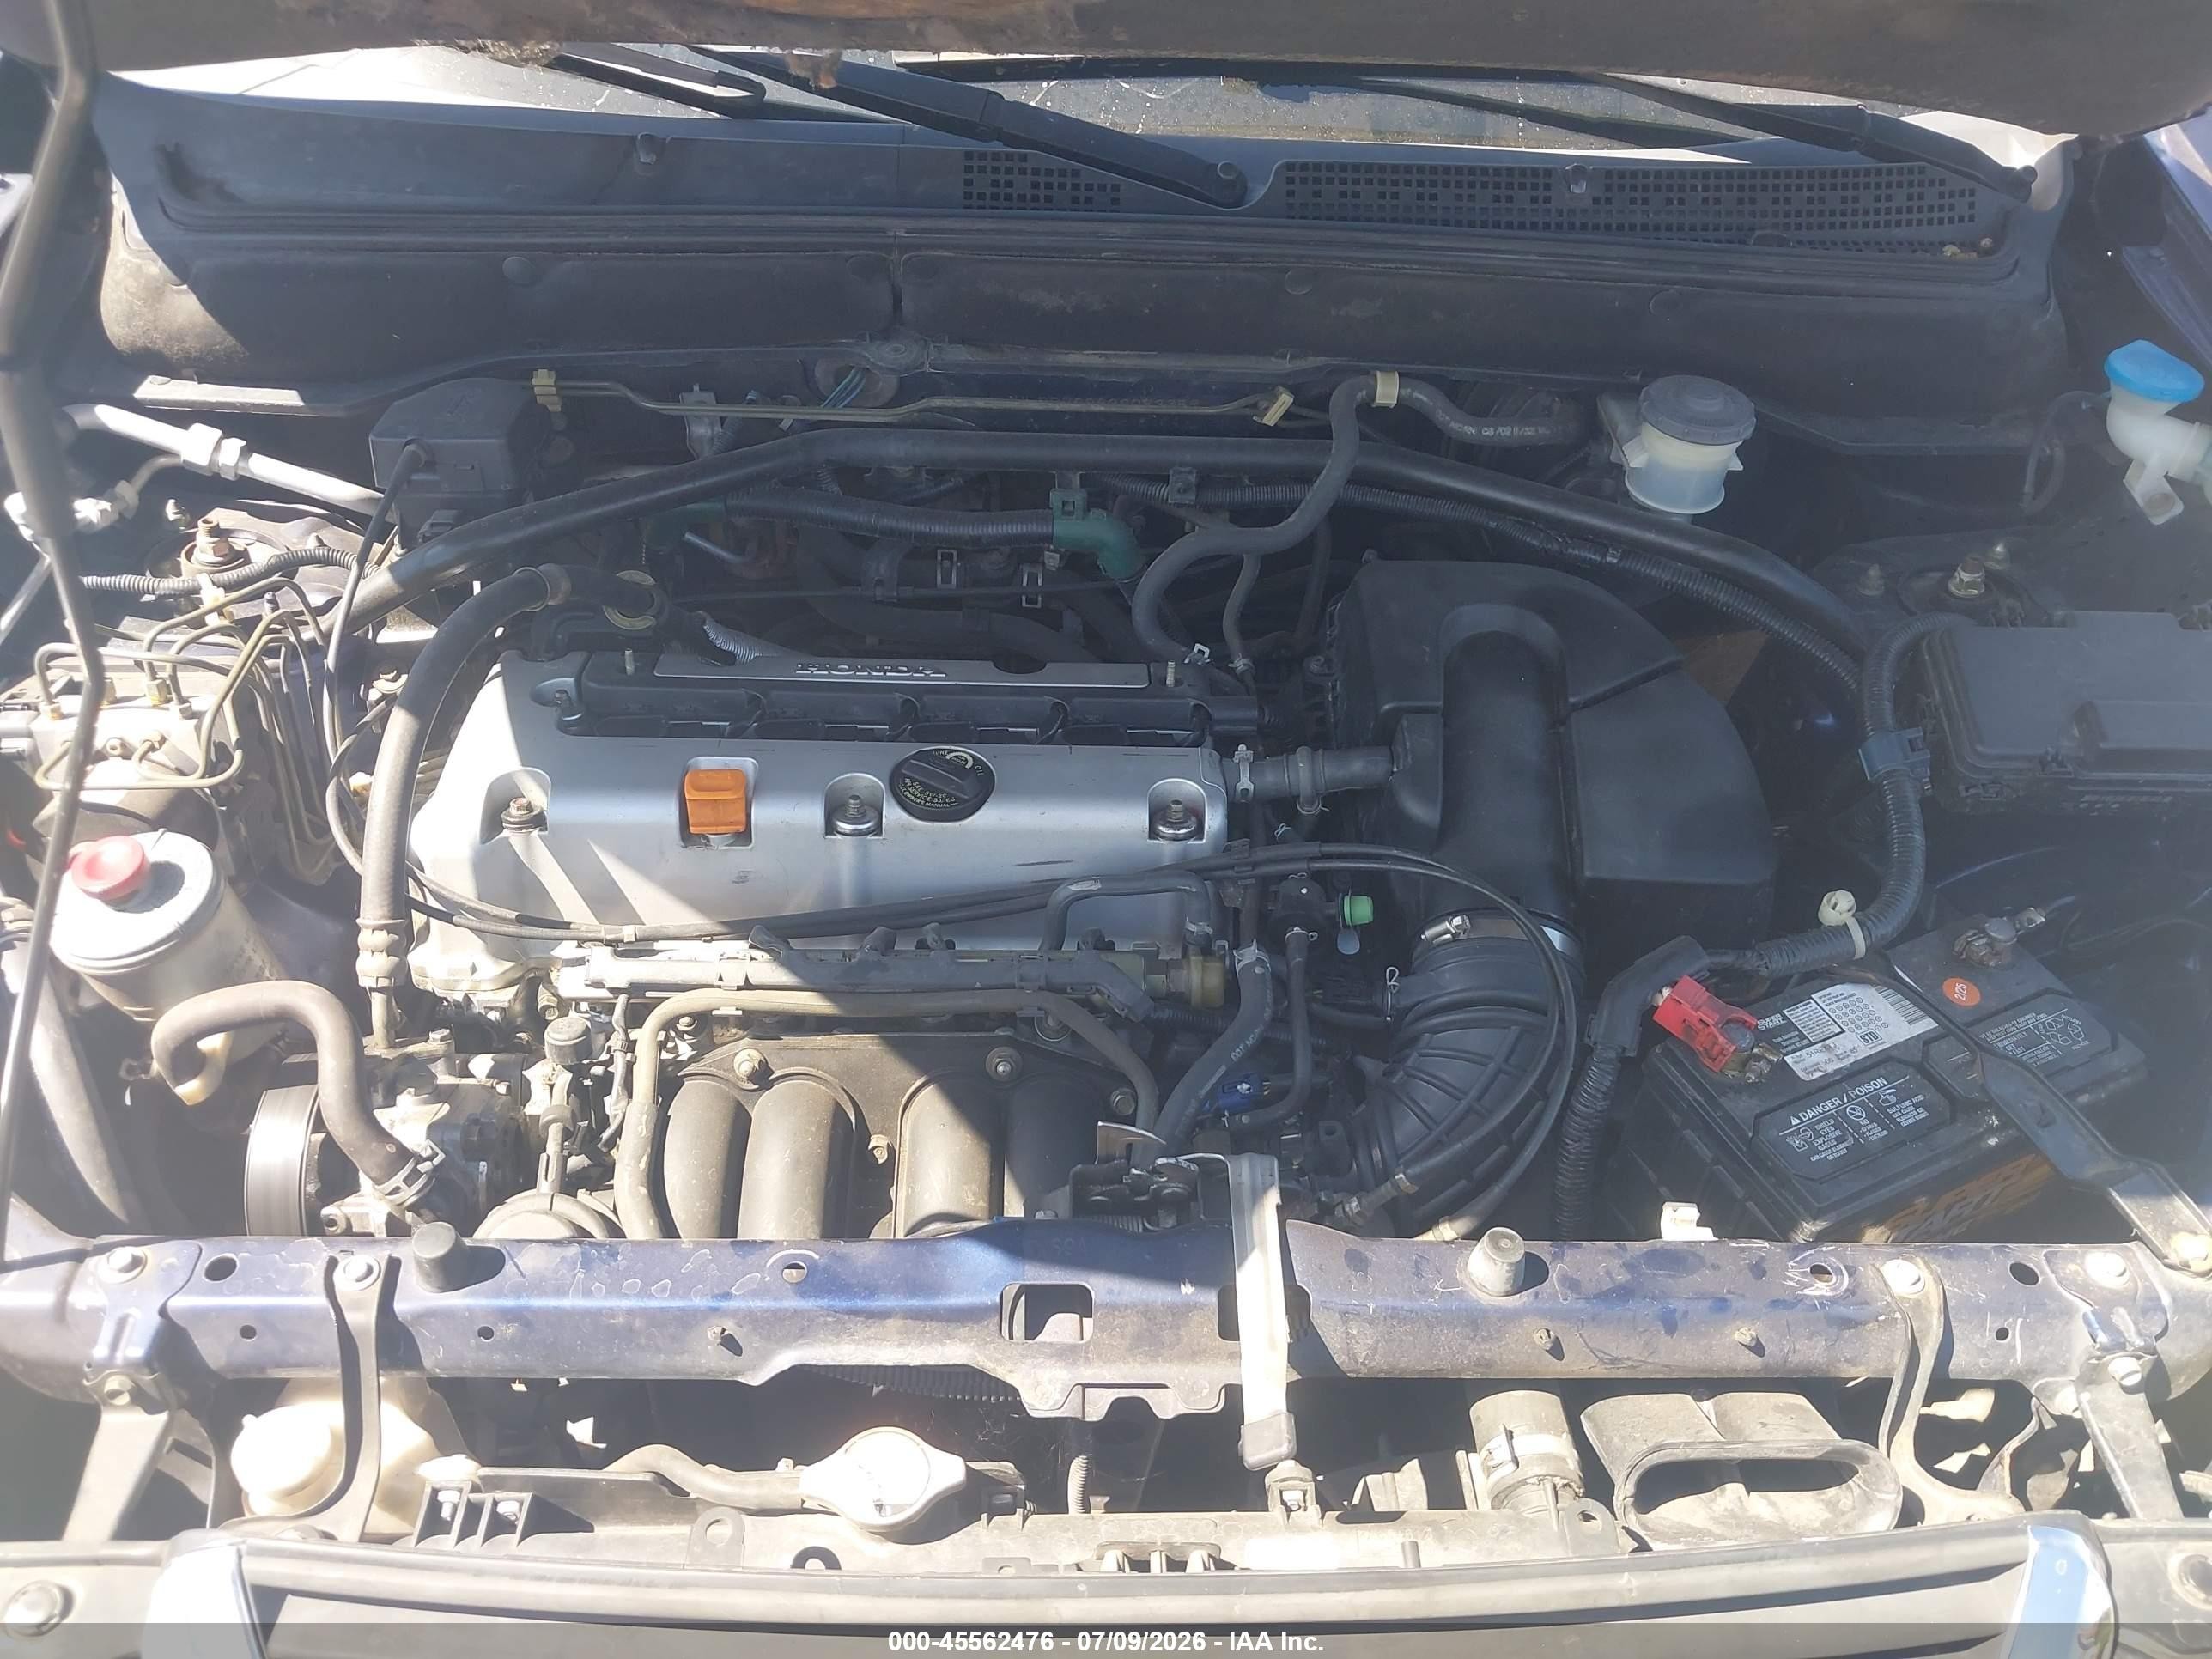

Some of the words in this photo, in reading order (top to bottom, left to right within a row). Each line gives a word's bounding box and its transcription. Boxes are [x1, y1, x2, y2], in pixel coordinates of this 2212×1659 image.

[795, 664, 946, 678] HONDA
[975, 765, 984, 776] OIL
[1954, 982, 1966, 1001] 2/25
[1758, 1018, 1787, 1031] START
[1859, 1031, 1878, 1044] STD
[1798, 1097, 1844, 1121] DANGER
[1848, 1077, 1888, 1100] POISON
